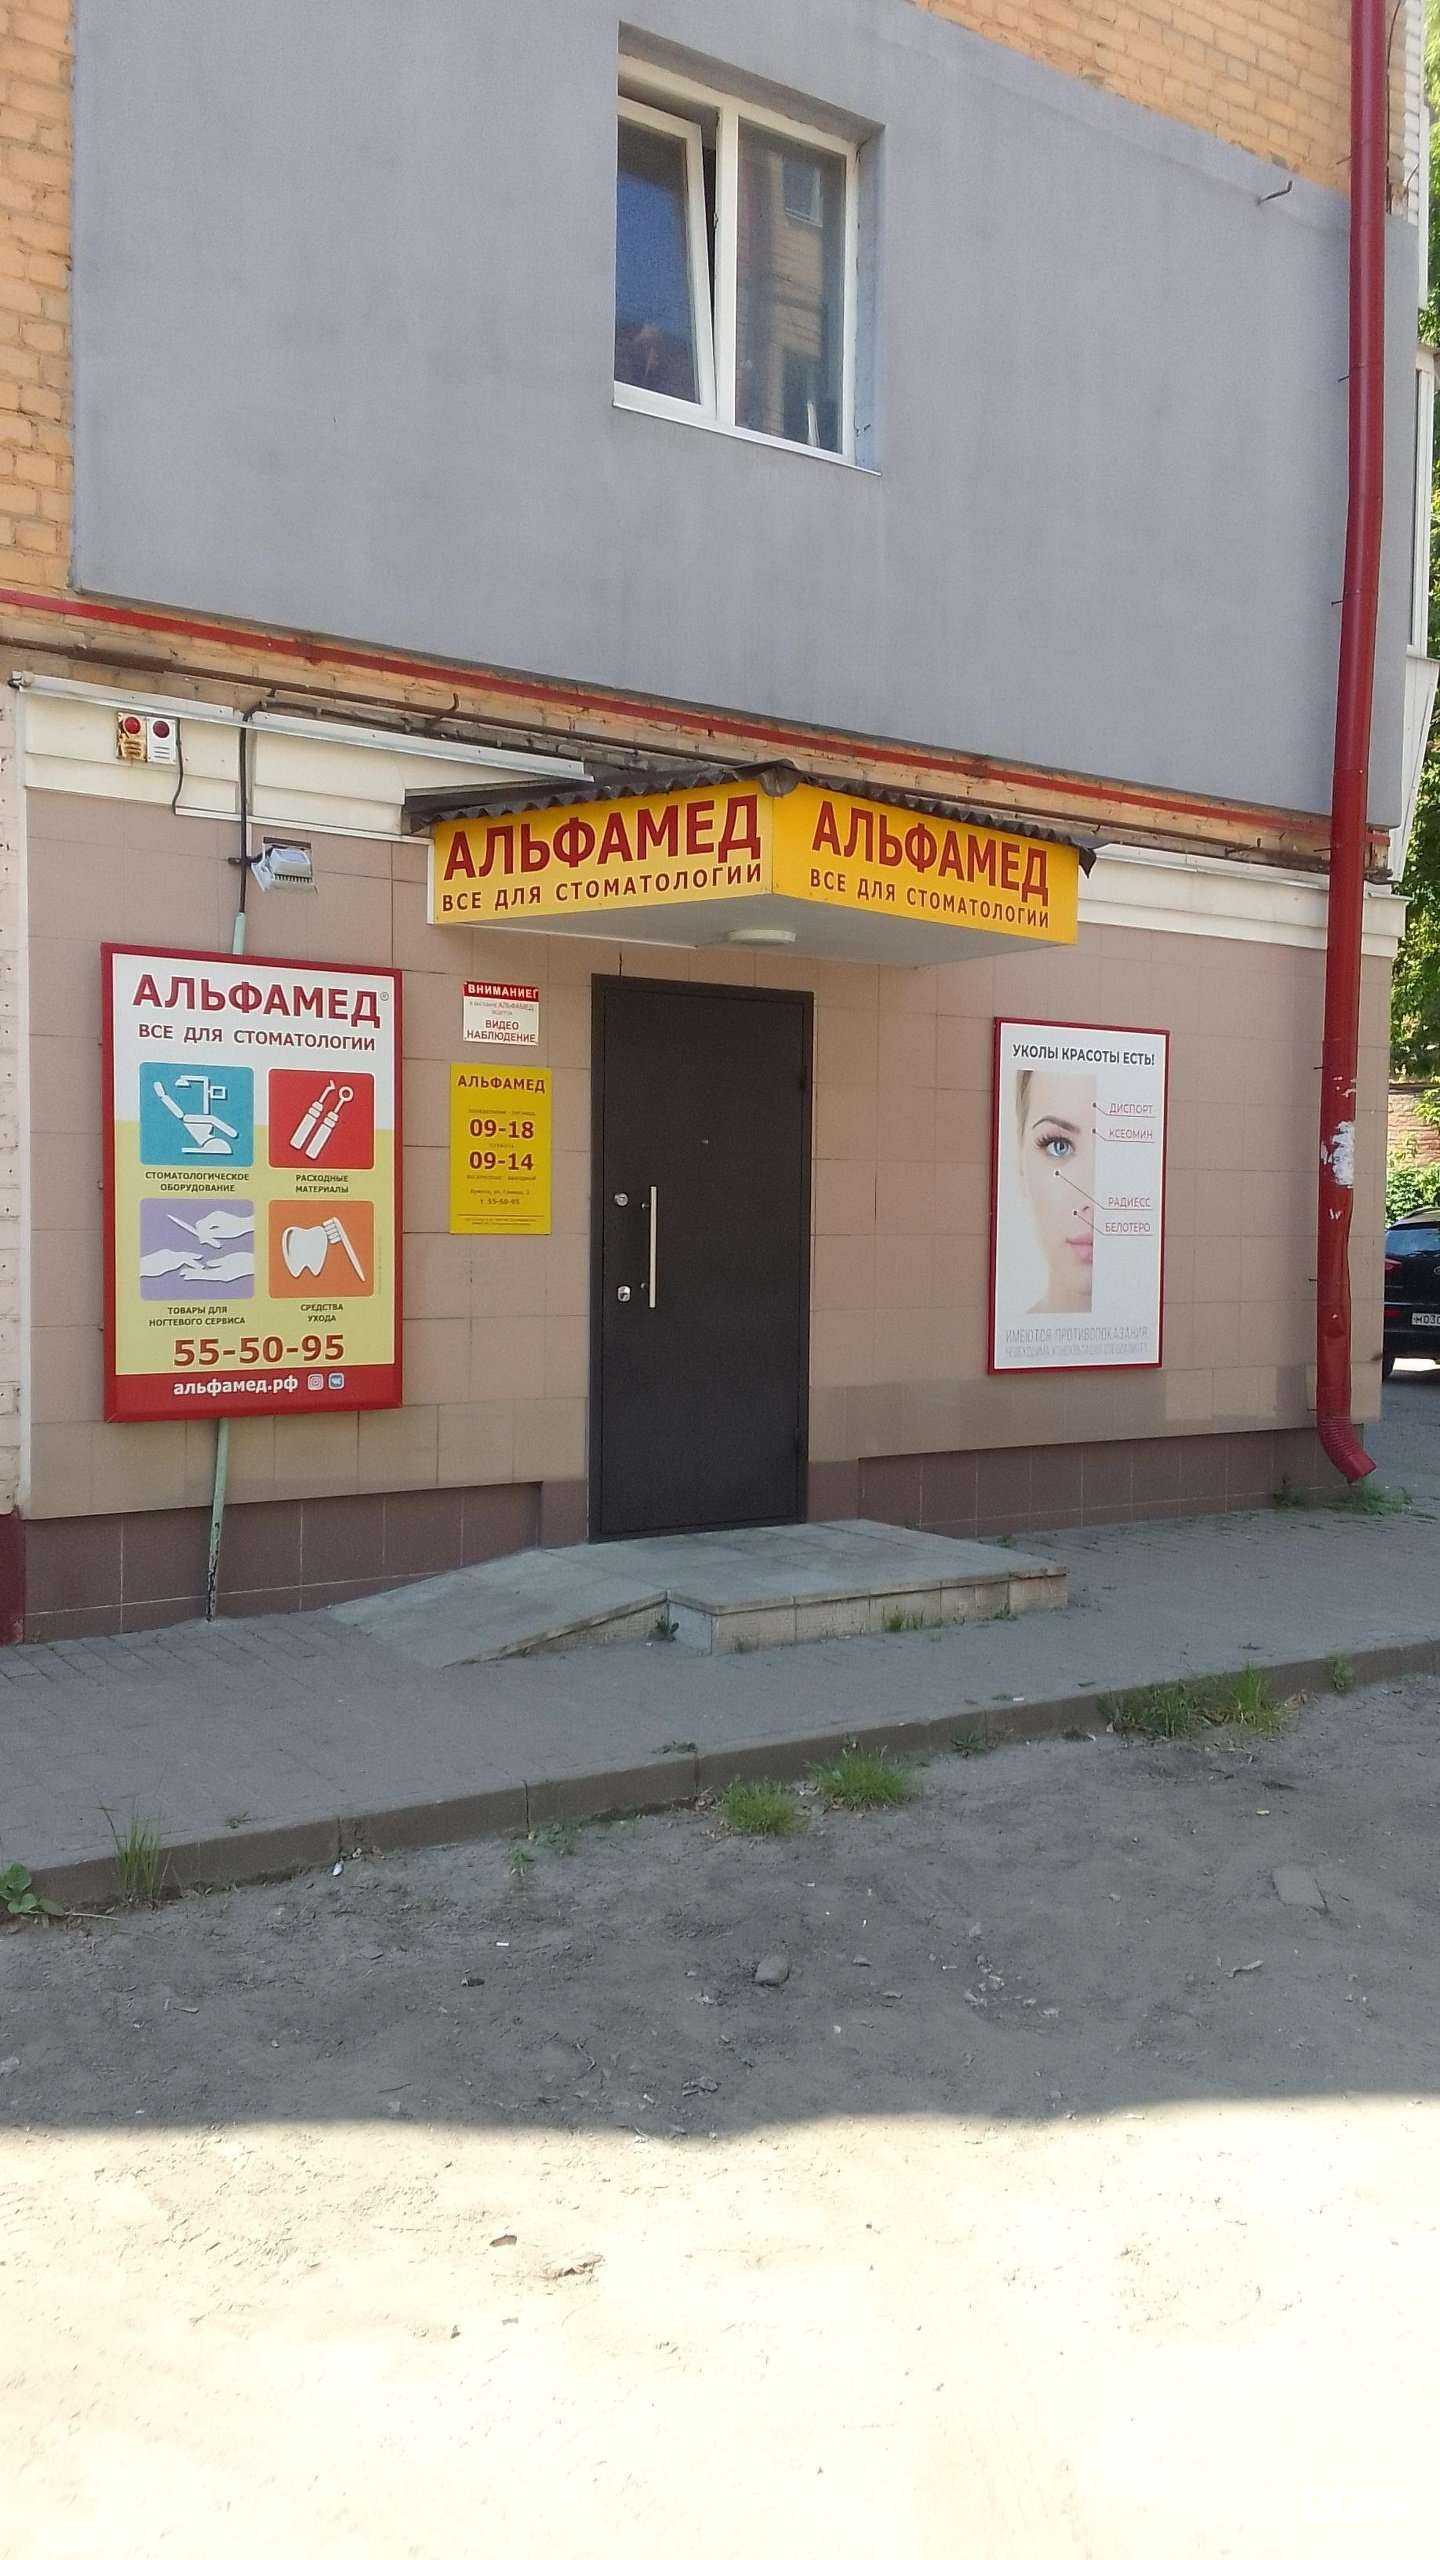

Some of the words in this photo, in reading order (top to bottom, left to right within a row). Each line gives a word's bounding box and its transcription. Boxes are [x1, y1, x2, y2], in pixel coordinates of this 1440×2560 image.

[443, 794, 762, 881] АЛЬФАМЕД
[811, 800, 1049, 907] АЛЬФАМЕД
[442, 891, 482, 912] ВСЕ
[494, 885, 541, 911] ДЛЯ
[556, 863, 762, 901] СТОМАТОЛОГИИ
[810, 868, 847, 892] ВСЕ
[857, 878, 896, 902] ДЛЯ
[906, 887, 1049, 928] СТОМАТОЛОГИИ
[132, 973, 381, 1029] АЛЬФАМЕД
[485, 1019, 519, 1030] ВИДЕО
[138, 1023, 174, 1039] ВСЕ
[183, 1026, 223, 1043] ДЛЯ
[233, 1030, 376, 1051] СТОМАТОЛОГИИ
[466, 1030, 536, 1043] НАБЛЮДЕНИЕ
[1012, 1043, 1059, 1059] УКОЛЫ
[1061, 1047, 1120, 1064] КРАСОТЫ
[1123, 1052, 1155, 1066] ЕСТЬ!
[457, 1075, 546, 1094] АЛЬФАМЕД
[1108, 1103, 1153, 1114] ДИСПОРТ
[469, 1118, 535, 1140] 09-18
[1109, 1128, 1153, 1140] КСЕОМИН
[469, 1151, 535, 1171] 09-14
[145, 1171, 249, 1181] СТОМАТОЛОГИЧЕСКОЕ
[295, 1174, 349, 1183] РАСХОДНЫЕ
[160, 1183, 236, 1193] ОБОРУДОВАНИЕ
[295, 1185, 349, 1194] МАТЕРИАЛЫ
[1105, 1222, 1151, 1233] БЕЛОТЕРО
[167, 1306, 206, 1315] ТОВАРЫ
[208, 1306, 228, 1315] ДЛЯ
[300, 1303, 344, 1312] СРЕДСТВА
[149, 1318, 203, 1327] НОГТЕВОГО
[205, 1317, 246, 1326] СЕРВИСА
[307, 1314, 337, 1323] УХОДА
[173, 1334, 345, 1367] 55-50-95
[173, 1375, 299, 1397] альфамед.рф
